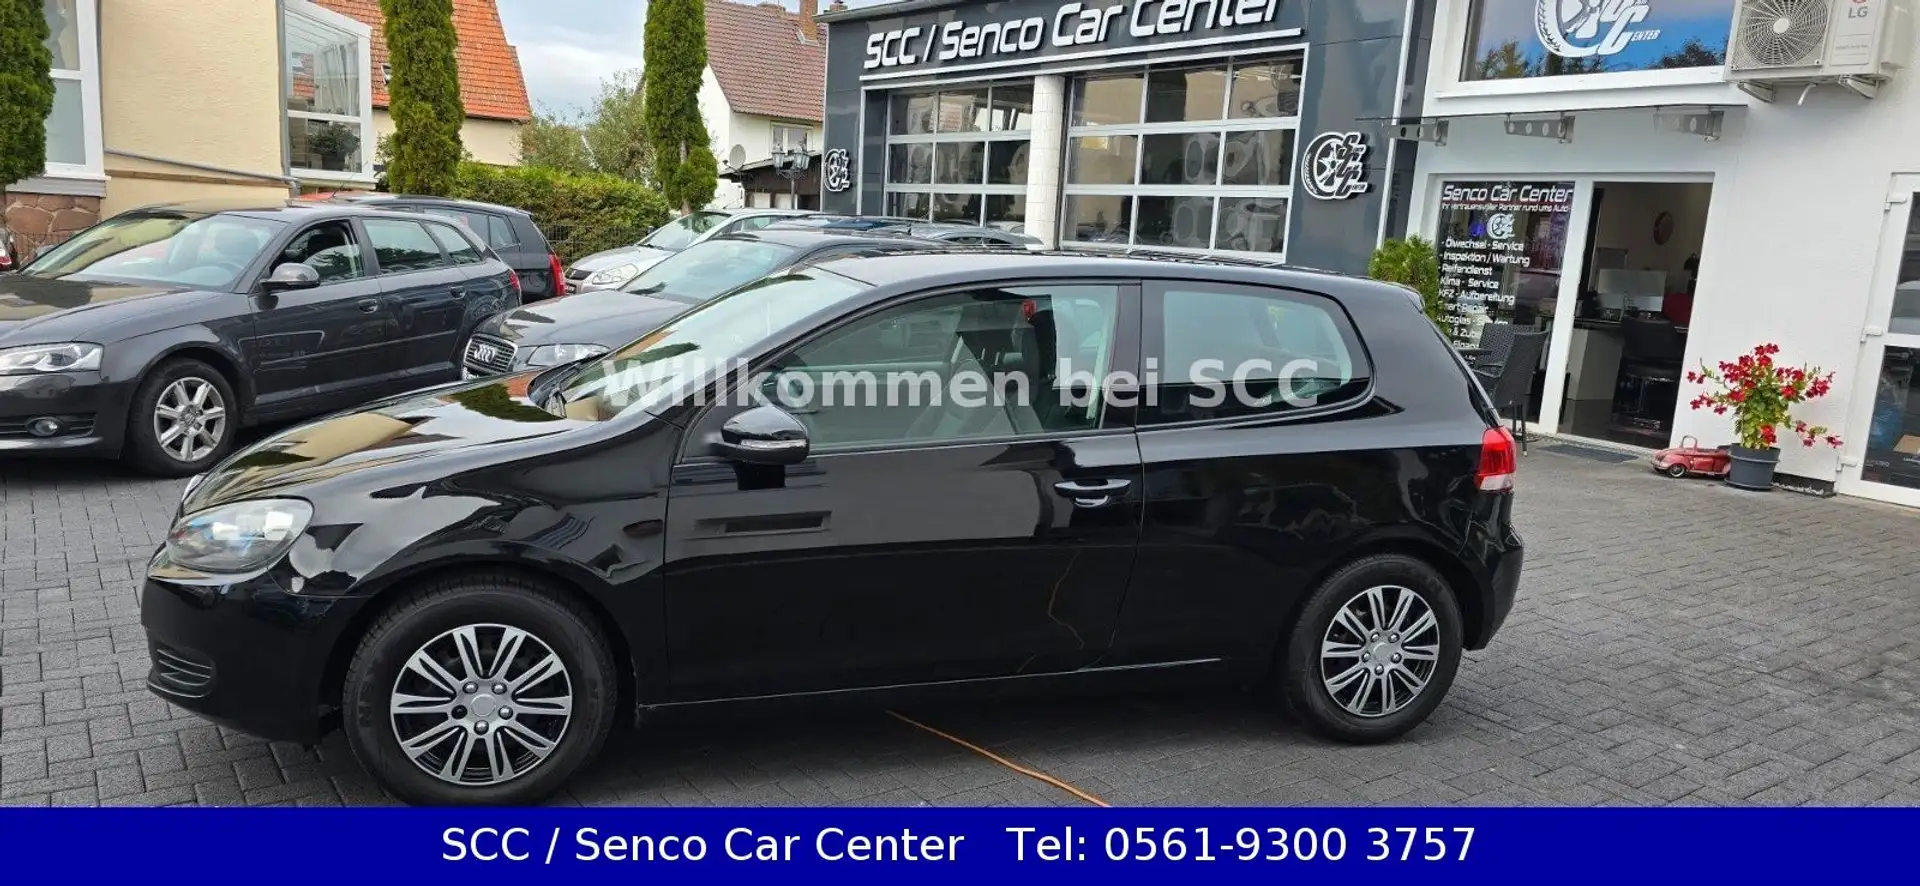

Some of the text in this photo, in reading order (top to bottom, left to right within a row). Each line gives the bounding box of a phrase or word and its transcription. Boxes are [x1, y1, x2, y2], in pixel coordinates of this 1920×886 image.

[1848, 6, 1868, 18] LG
[864, 0, 1278, 69] SCC / Senco Car Center
[1443, 185, 1573, 203] Senco Car Center
[1492, 240, 1524, 251] Service
[1443, 251, 1487, 262] Inspektion
[1492, 253, 1530, 267] Wartung
[1442, 263, 1493, 275] Reifendienst
[1468, 278, 1499, 289] Service
[1460, 290, 1516, 306] Aufbereitung
